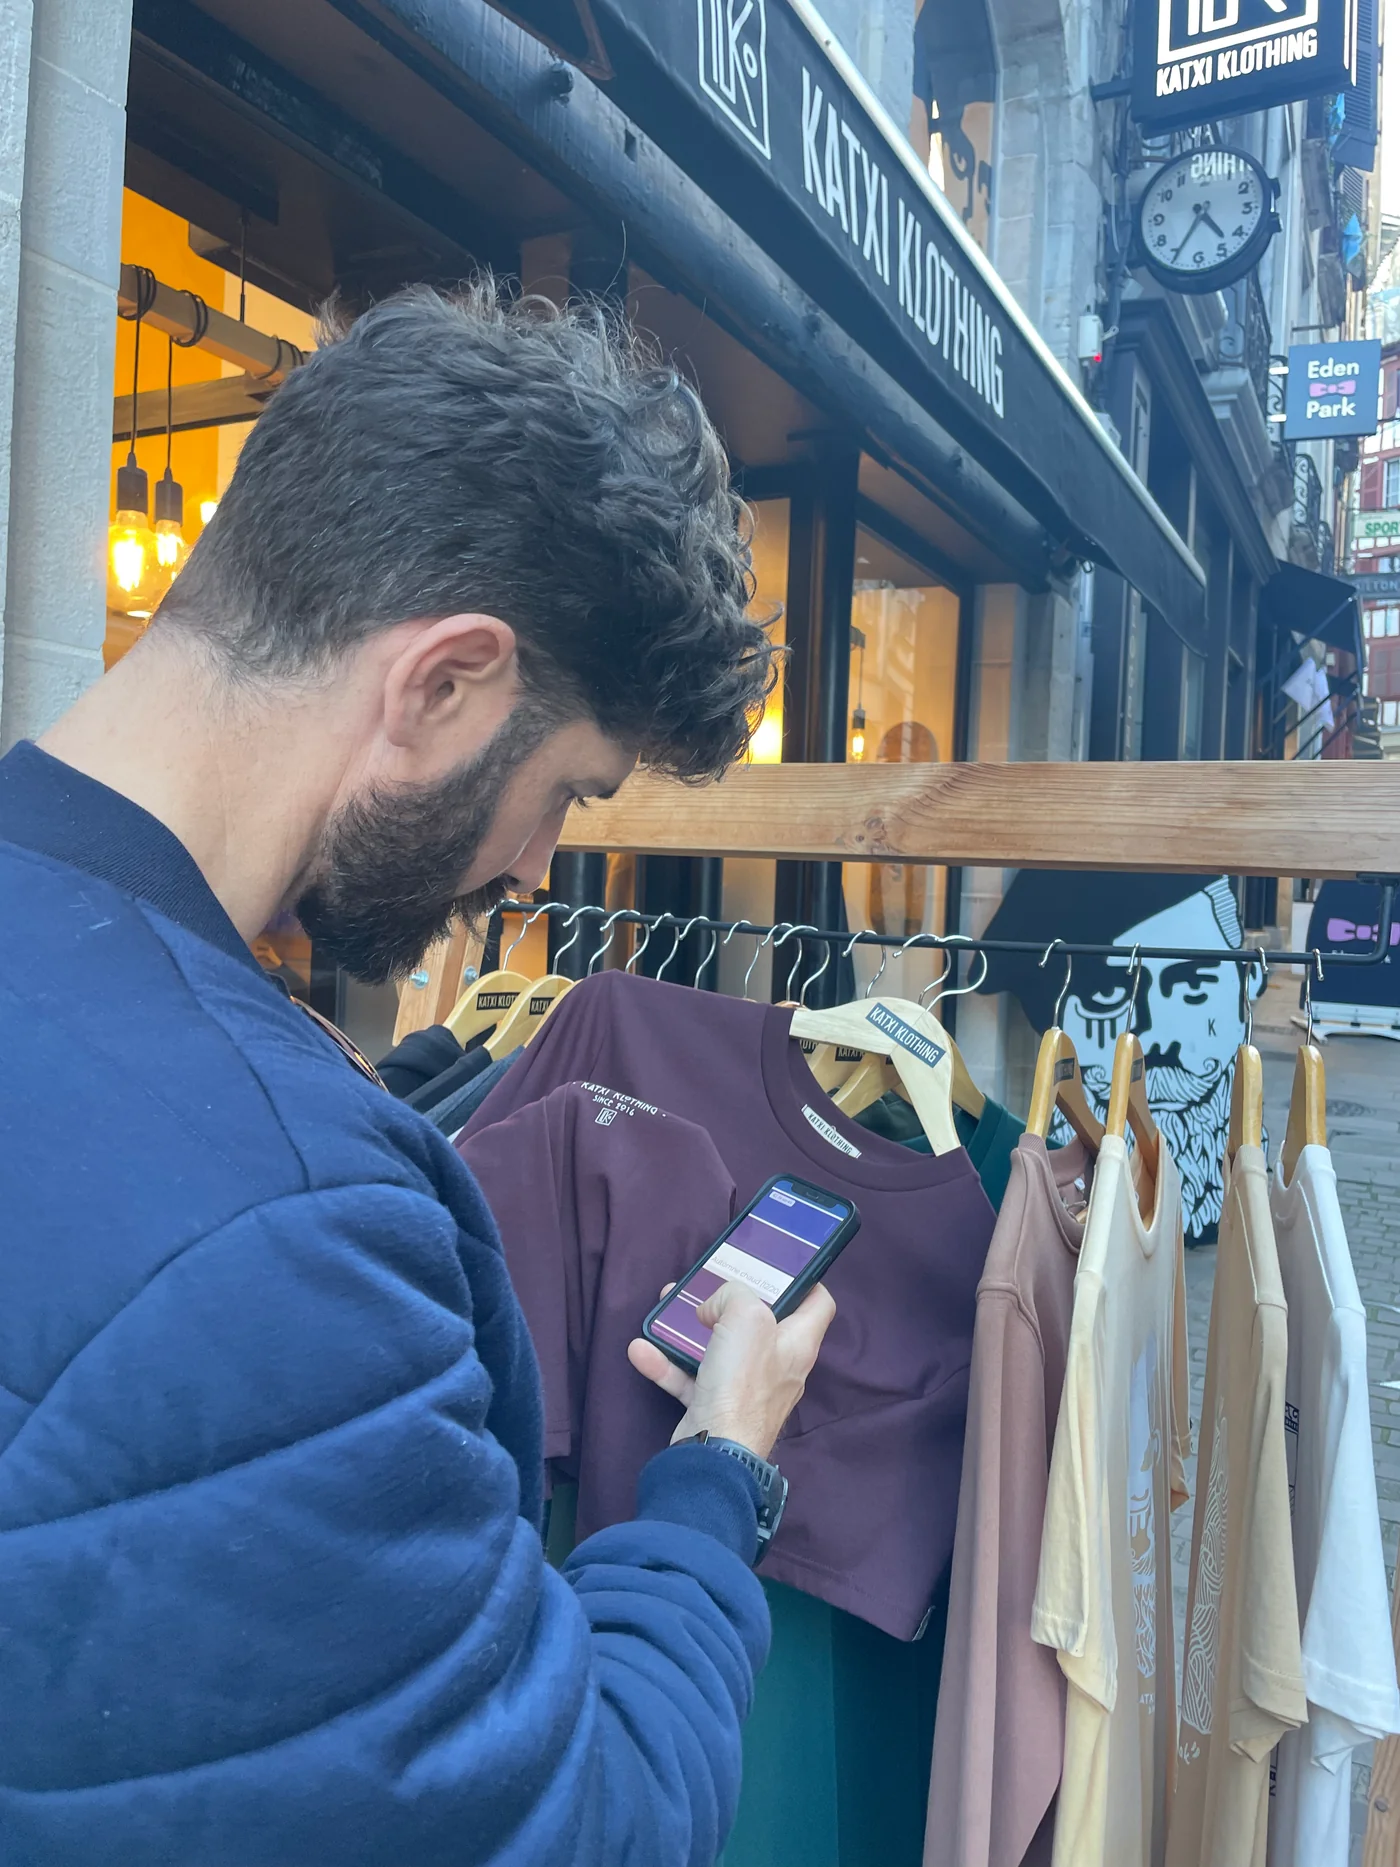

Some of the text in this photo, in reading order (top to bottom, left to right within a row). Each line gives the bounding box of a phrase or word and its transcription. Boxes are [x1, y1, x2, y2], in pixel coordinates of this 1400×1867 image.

[1156, 28, 1318, 97] KATXI KLOTHING
[1160, 189, 1173, 203] 10
[1237, 181, 1249, 195] 2
[1241, 202, 1253, 215] 3
[1153, 213, 1165, 226] 9
[1232, 225, 1244, 238] 4
[802, 66, 1005, 419] KATXI KLOTHING
[1156, 234, 1167, 247] 8
[1192, 252, 1205, 264] 6
[1216, 243, 1228, 258] 5
[1307, 357, 1360, 379] Eden
[1306, 396, 1356, 419] Park
[1364, 521, 1400, 536] SPOR
[478, 996, 498, 1008] KATXI
[870, 1006, 940, 1063] KATXI KLOTHING
[1208, 1018, 1217, 1037] K
[580, 1081, 659, 1116] KATXI KLOTHING
[592, 1094, 636, 1117] SINCE 2016
[807, 1113, 853, 1155] KATXI KLOTHING
[712, 1255, 741, 1277] Automne
[740, 1271, 763, 1286] chaud
